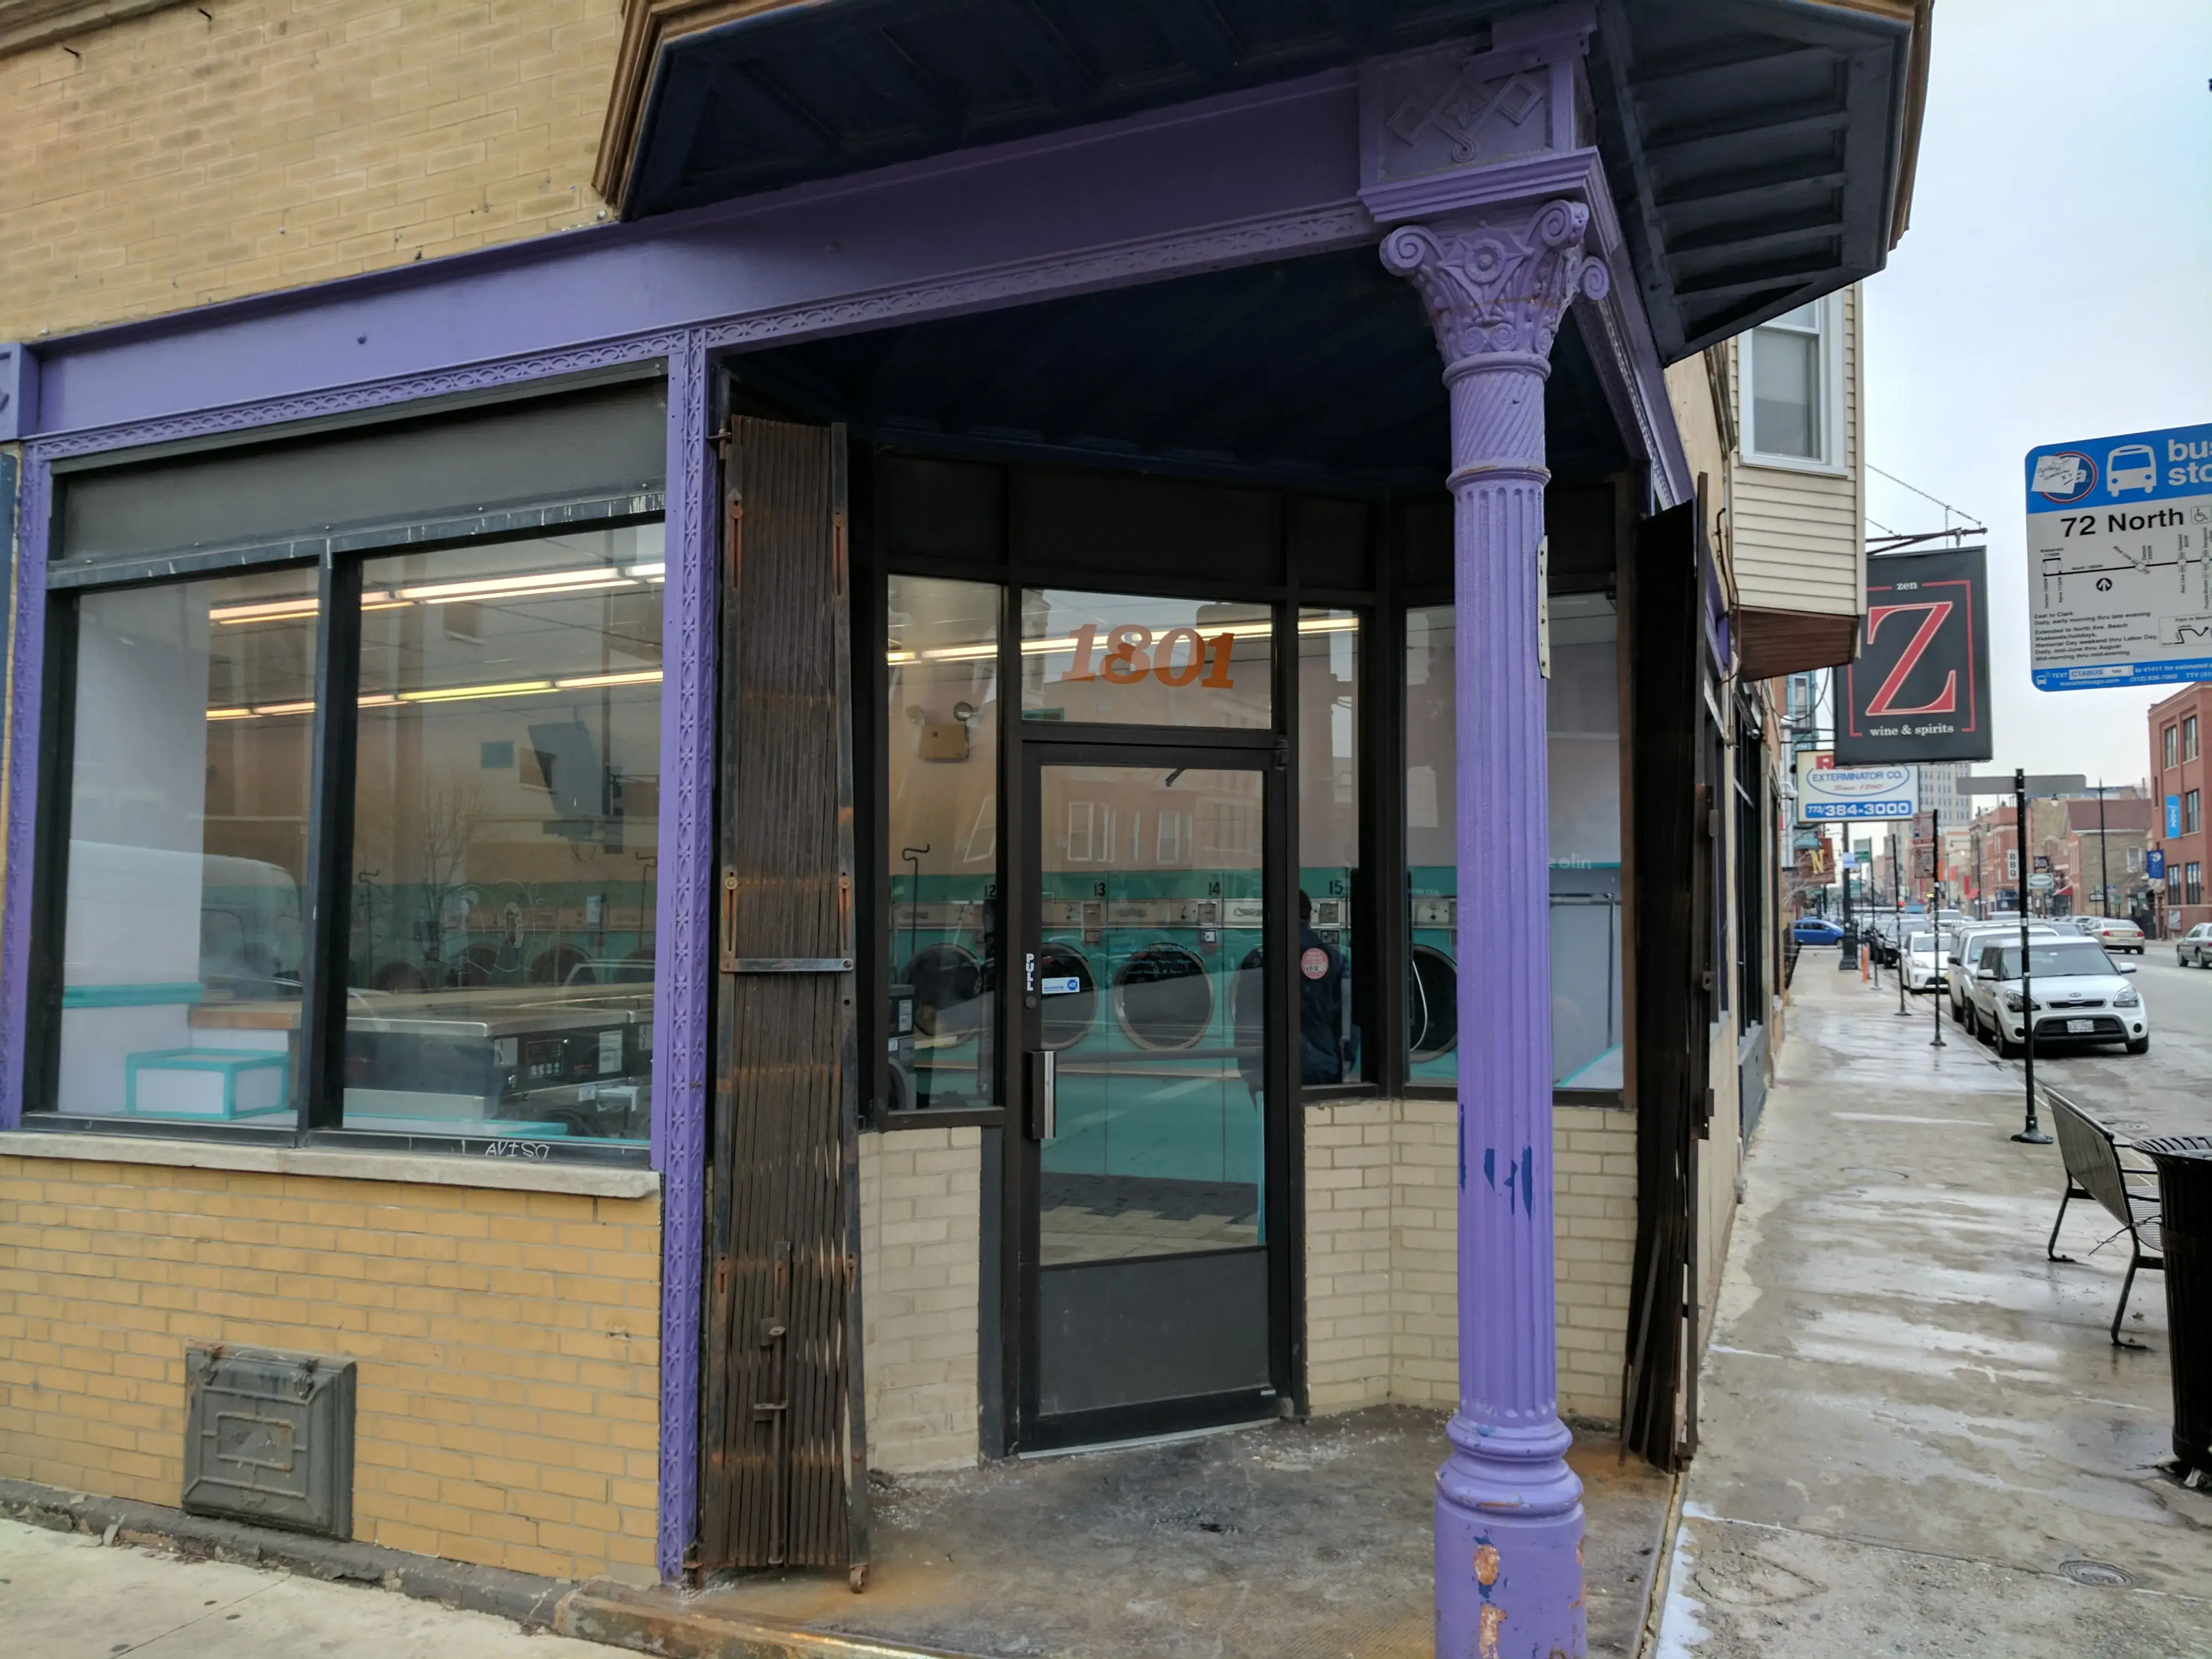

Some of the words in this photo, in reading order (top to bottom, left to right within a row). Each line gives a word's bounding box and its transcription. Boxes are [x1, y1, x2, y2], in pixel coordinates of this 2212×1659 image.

[2168, 439, 2212, 462] bu
[2061, 515, 2096, 537] 72
[2108, 508, 2184, 532] North
[1896, 581, 1918, 591] zen
[1061, 623, 1235, 689] 1801
[1866, 601, 1956, 716] Z
[2071, 669, 2103, 677] CTABUS
[1869, 725, 1899, 736] wine
[1901, 724, 1911, 736] &
[1914, 722, 1954, 737] spirits
[1813, 770, 1884, 782] EXTERMINATOR
[1886, 770, 1903, 780] CO.
[984, 885, 996, 897] 12
[1094, 883, 1106, 897] 13
[1209, 882, 1220, 896] 14
[1329, 880, 1344, 895] 15
[1025, 953, 1034, 991] PULL
